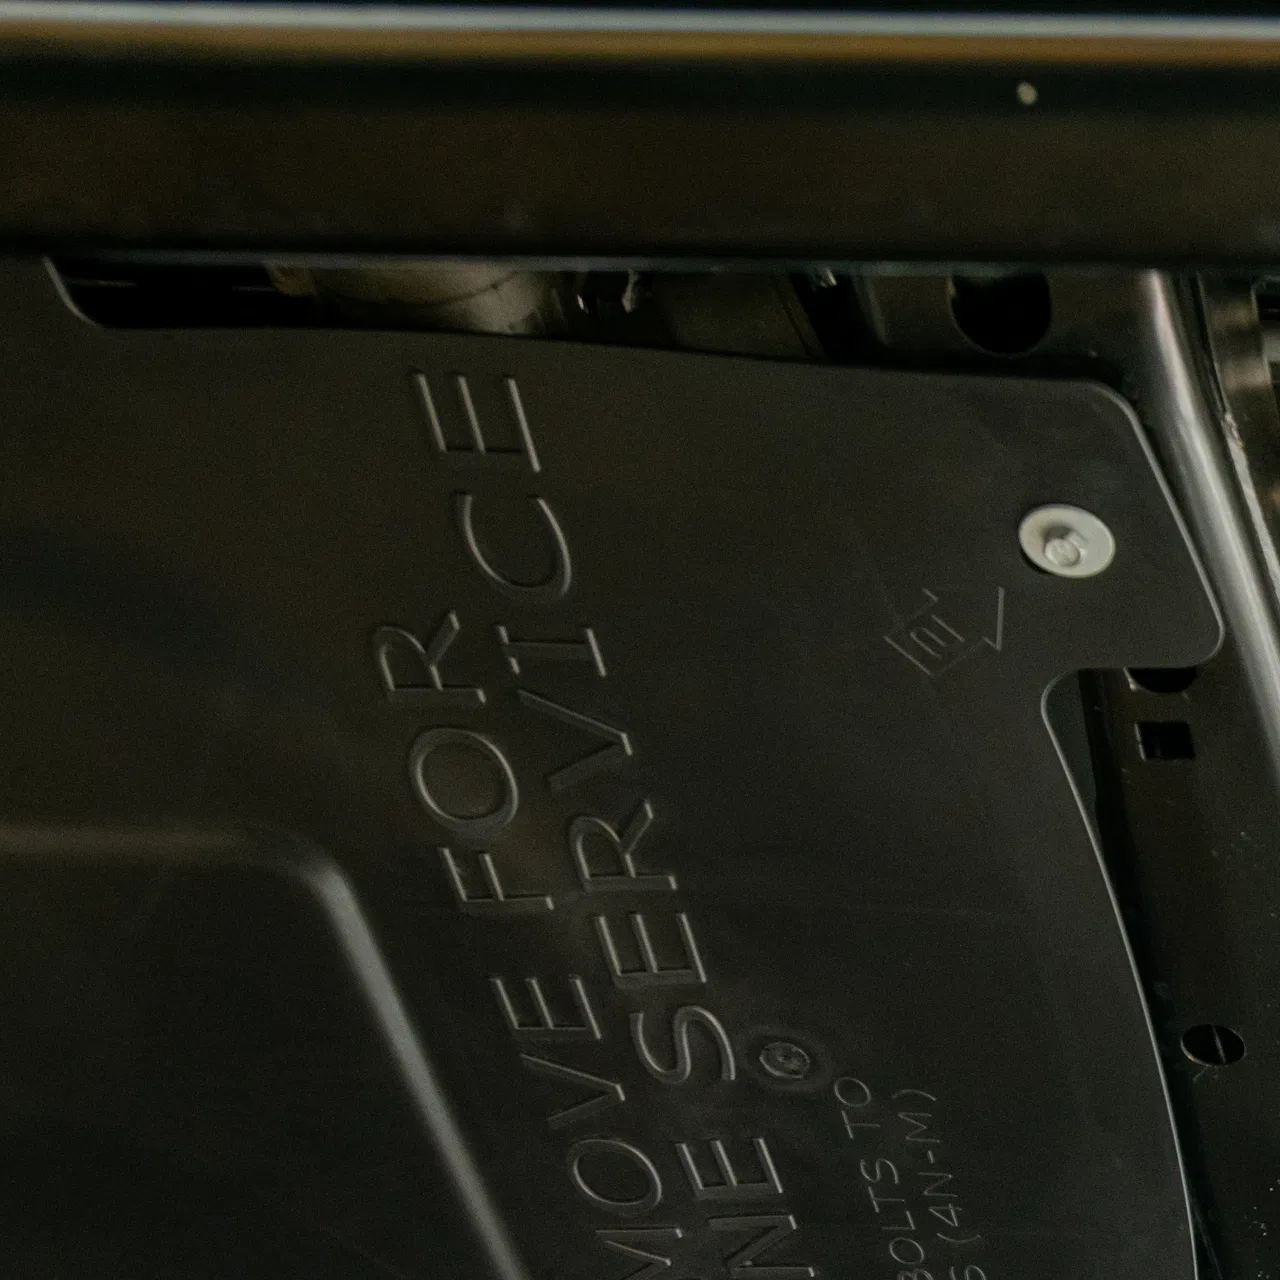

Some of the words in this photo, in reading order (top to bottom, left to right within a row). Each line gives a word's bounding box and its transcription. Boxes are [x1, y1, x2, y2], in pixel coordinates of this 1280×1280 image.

[371, 606, 555, 911] FOR
[409, 367, 736, 1084] SERVICE
[832, 1075, 881, 1139] TO
[890, 1087, 981, 1244] (4N-M)
